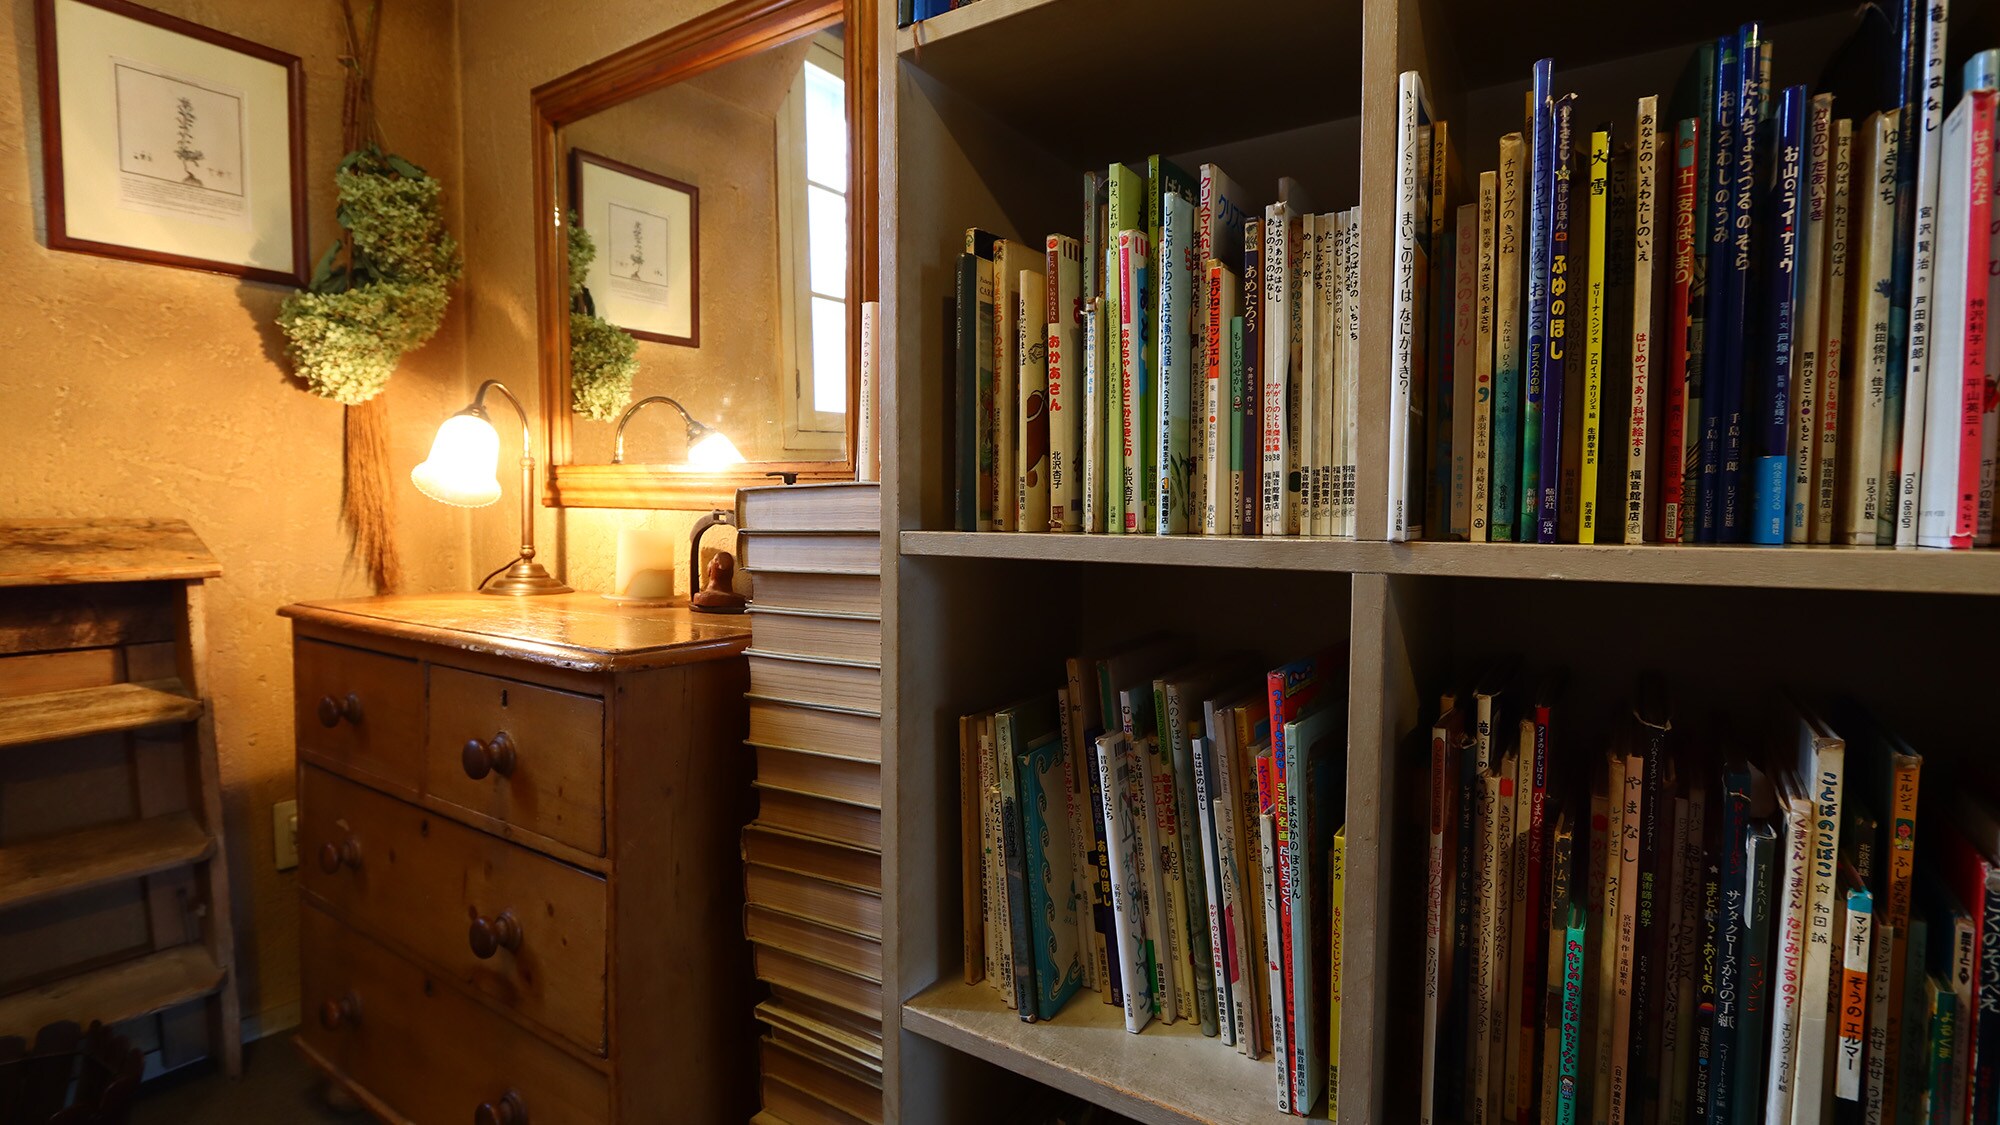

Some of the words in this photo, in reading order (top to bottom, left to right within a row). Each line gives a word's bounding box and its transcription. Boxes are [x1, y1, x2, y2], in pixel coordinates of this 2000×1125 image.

[1559, 106, 1572, 160] かこさとし
[1434, 142, 1443, 196] ウクライナ民話
[1502, 158, 1516, 219] チロヌップの
[1590, 149, 1607, 196] 大雪
[1637, 115, 1654, 263] あなたのいえわたしのいえ
[1835, 135, 1852, 197] ぼくのばん
[1880, 130, 1899, 206] ゆきみち
[1972, 130, 1991, 205] はるがきたよ
[1110, 180, 1118, 229] ねえ、どれが
[1483, 190, 1491, 221] 日本の神話
[1555, 184, 1569, 231] ほしのほん
[1674, 169, 1694, 285] 十二支のはじまり
[1779, 147, 1800, 276] お山のライチョウ
[1193, 232, 1201, 249] ねえ
[1199, 177, 1211, 284] クリスマスれっしゃ
[1325, 231, 1333, 253] たこ
[1335, 230, 1343, 267] みのむし
[1502, 224, 1515, 255] きつね
[1831, 205, 1849, 279] わたしのばん
[1917, 206, 1933, 270] 宮沢賢治
[1193, 253, 1201, 270] ねえ
[1266, 219, 1275, 300] あしのうらのはなし
[1275, 220, 1283, 302] はなのあなのはなし
[1303, 233, 1311, 278] めだか
[1314, 236, 1324, 290] あしながばち
[1350, 222, 1360, 298] きゃべつばたけの
[1481, 254, 1492, 294] うみさち
[1917, 275, 1926, 284] 作
[1163, 207, 1174, 366] しりたがりやのちいさな魚のお話
[1244, 266, 1258, 333] あめたろう
[1456, 229, 1472, 347] ももいろのきりん
[1549, 257, 1568, 361] ふゆのほし
[1209, 278, 1220, 367] ちびねこミッシェル
[1350, 305, 1359, 341] いちにち
[1480, 297, 1491, 334] やまさち
[1502, 320, 1511, 350] たかはし
[1911, 296, 1926, 361] 戸田幸四郎
[1969, 298, 1985, 345] 神沢利子
[1048, 335, 1061, 412] おかあさん
[1232, 332, 1242, 393] もしものせかい
[1399, 307, 1412, 395] なにがすき?
[1502, 354, 1510, 384] ひろゆき
[1530, 344, 1541, 394] アラスカの詩
[1776, 333, 1789, 366] 戸塚学
[1871, 322, 1887, 398] 梅田俊作・佳子
[1120, 329, 1132, 457] あかちゃんはどこからきたの
[1589, 352, 1599, 410] アロイス・カリジェ
[1631, 333, 1647, 448] はじめてであう科学絵本
[1800, 352, 1814, 407] 間所ひさこ・作
[1824, 338, 1841, 431] かがくのとも傑作集
[1964, 378, 1981, 425] 平山英三
[1265, 383, 1274, 451] かがくのとも傑作集
[1273, 383, 1281, 451] かがくのとも傑作集
[1799, 416, 1811, 441] いもと
[1822, 434, 1836, 443] 23
[1208, 424, 1216, 462] 和歌山静子
[1273, 453, 1281, 461] 38
[1632, 449, 1641, 457] 3
[1703, 417, 1720, 474] 手島圭三郎
[1725, 413, 1742, 473] 手島圭三郎
[1796, 446, 1811, 484] ようこ・絵
[1053, 451, 1062, 489] 北沢杏子
[1124, 466, 1134, 506] 北沢杏子
[1264, 472, 1272, 510] 福音館書店
[1272, 471, 1280, 509] 福音館書店
[1301, 466, 1309, 505] 福音館書店
[1313, 469, 1321, 508] 福音館書店
[1321, 466, 1330, 504] 福音館書店
[1332, 466, 1341, 505] 福音館書店
[1347, 465, 1355, 504] 福音館書店
[1820, 461, 1834, 509] 福音館書店
[1904, 472, 1916, 496] Toda
[1978, 459, 1993, 518] キーツの絵本
[1161, 495, 1170, 524] 徳間書店
[1207, 504, 1216, 527] 童心社
[1475, 503, 1484, 512] 文
[1544, 487, 1555, 509] 偕成社
[1583, 502, 1592, 530] 岩波書店
[1627, 472, 1641, 522] 福音館書店
[1863, 477, 1877, 520] ほるぷ出版
[1901, 500, 1913, 529] design
[1961, 493, 1974, 520] 童心社
[1069, 675, 1082, 712] 八郎
[1168, 695, 1182, 751] 天のひぼこ
[1272, 690, 1286, 779] ウォーリーをさがせ!
[1535, 726, 1546, 788] アイヌのむかしばなし
[1134, 756, 1147, 820] ななほしてんとう
[1194, 753, 1206, 811] はははのはなし
[1520, 759, 1529, 806] エリック・カール
[1899, 773, 1912, 813] エルジェ
[1288, 795, 1300, 851] まよなかの
[1529, 792, 1544, 864] ひまなこなべ
[1623, 776, 1642, 864] やまなし
[1794, 818, 1807, 861] くまさん
[1816, 771, 1838, 878] ことばのこばこ
[1096, 840, 1112, 907] あきのほし
[1291, 855, 1302, 900] ぼうけん
[1607, 877, 1619, 917] スイミー
[1789, 866, 1804, 909] くまさん
[1640, 871, 1655, 928] 魔術師の弟子
[1703, 881, 1719, 934] まどから
[1811, 902, 1830, 945] 和田誠
[1209, 904, 1223, 970] かがくのとも傑作集
[1622, 914, 1632, 943] 宮沢賢治
[1852, 915, 1869, 956] マッキー
[1331, 906, 1342, 1004] もぐらとじどうしゃ
[1701, 942, 1716, 995] おくりもの
[1717, 889, 1741, 1030] サンタクロースからの手紙
[1782, 916, 1802, 1008] なにみてるの?
[1216, 986, 1227, 1023] 福音館書店
[1564, 939, 1583, 1021] わたしのわごむは
[1561, 1022, 1577, 1072] わたさない
[1697, 1026, 1712, 1058] 五味太郎
[1781, 1023, 1791, 1084] エリック・カール
[1296, 1048, 1306, 1087] 福音館書店
[1328, 1064, 1338, 1104] 福音館書店
